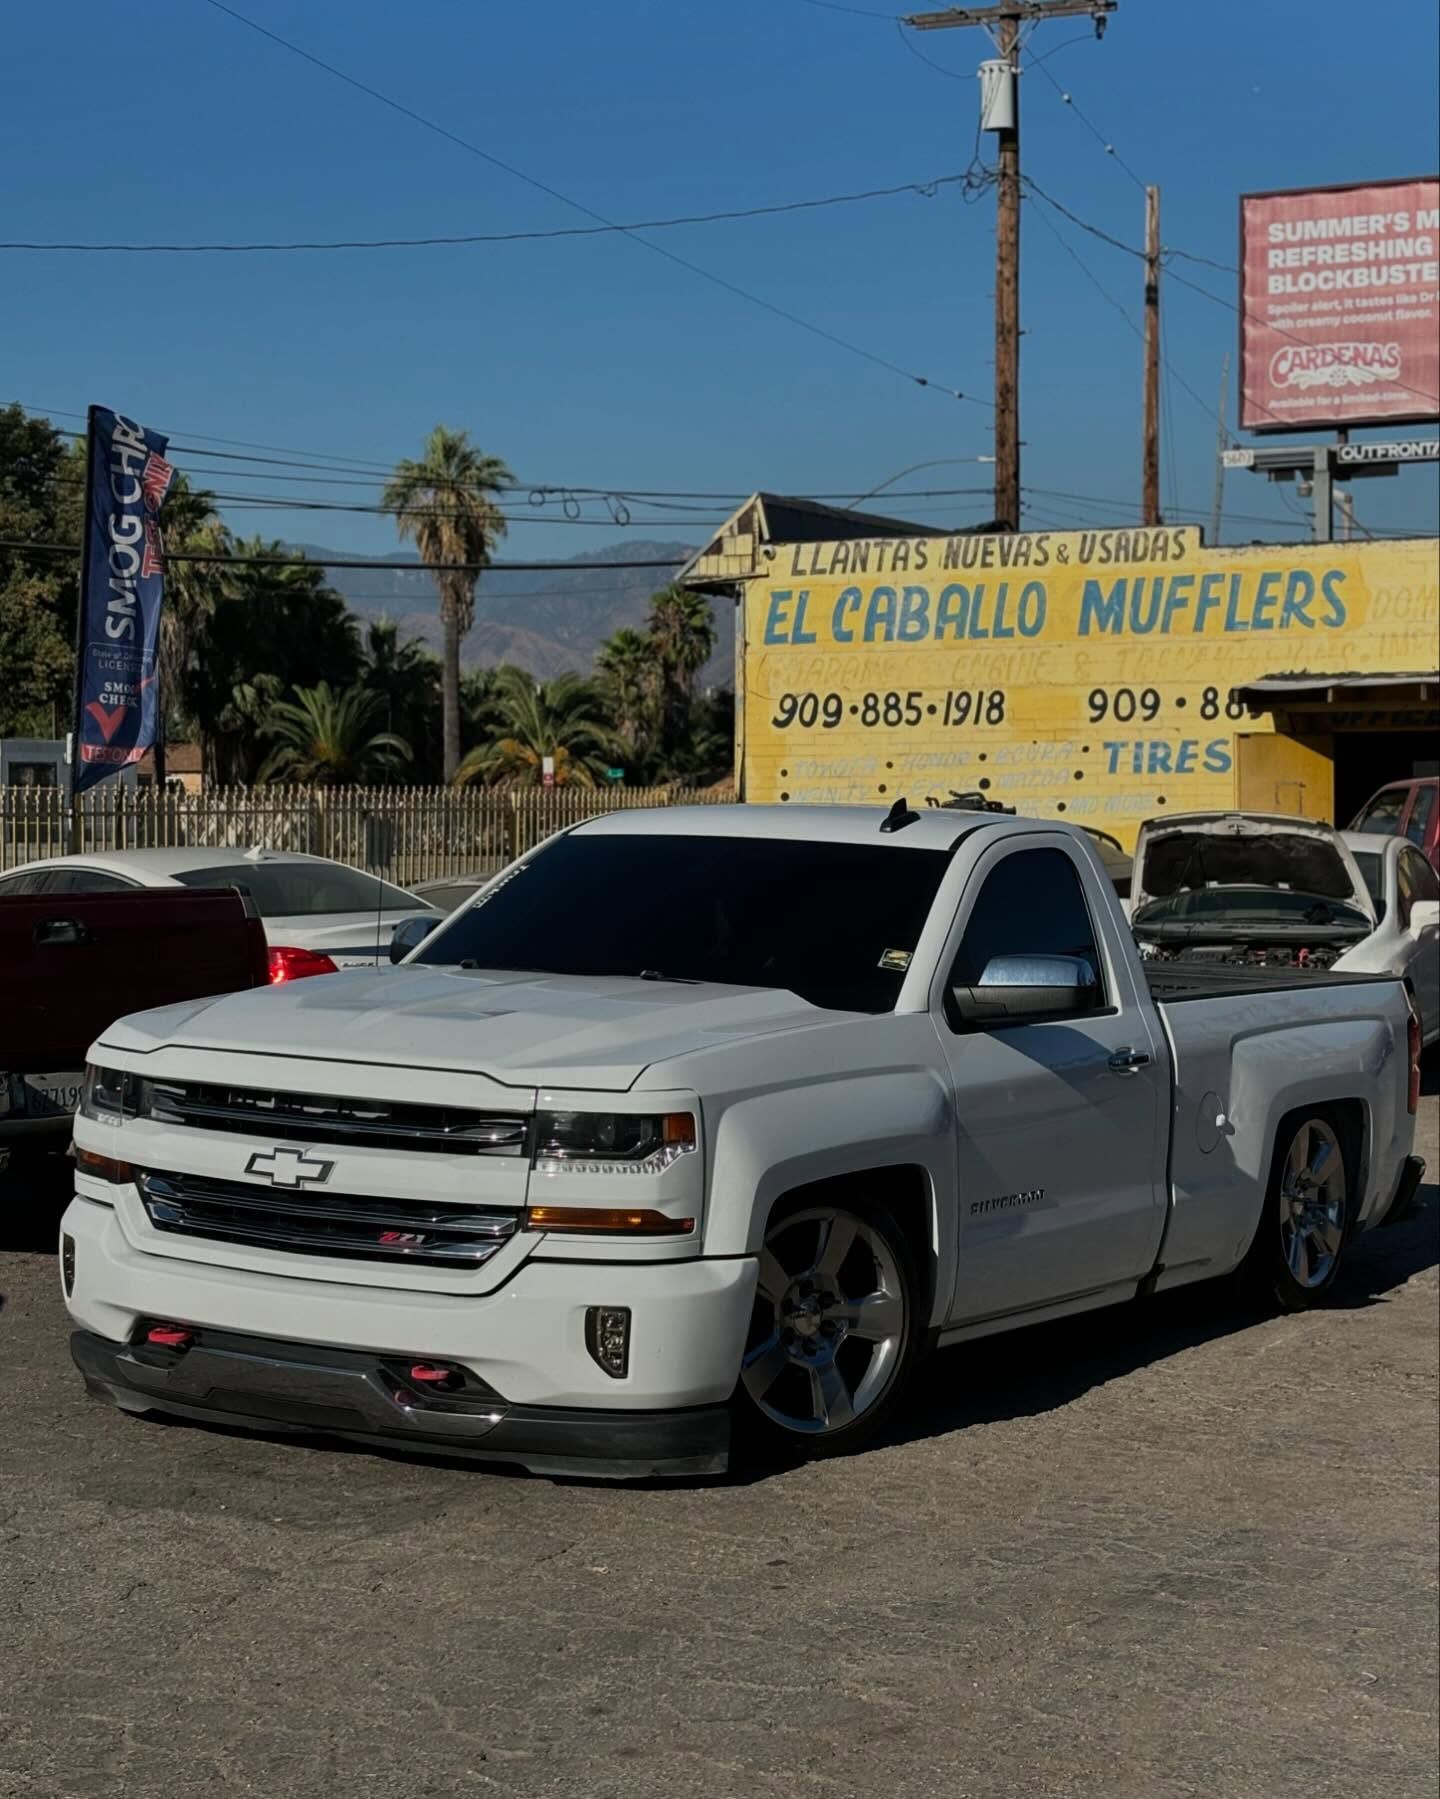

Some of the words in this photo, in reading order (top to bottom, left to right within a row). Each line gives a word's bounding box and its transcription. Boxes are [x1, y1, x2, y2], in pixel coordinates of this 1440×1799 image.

[1268, 211, 1410, 244] SUMMER'S
[1268, 236, 1432, 270] REFRESHING
[1270, 342, 1400, 388] CARDENAS
[790, 540, 928, 577] LLANTAS
[942, 535, 1050, 570] NUEVAS
[1056, 543, 1070, 563] &
[1078, 528, 1187, 565] USADAS
[105, 513, 144, 641] SMOG
[763, 590, 817, 646] EL
[831, 580, 1048, 643] CABALLO
[1077, 569, 1347, 637] MUFFLERS
[1103, 738, 1232, 774] TIRES
